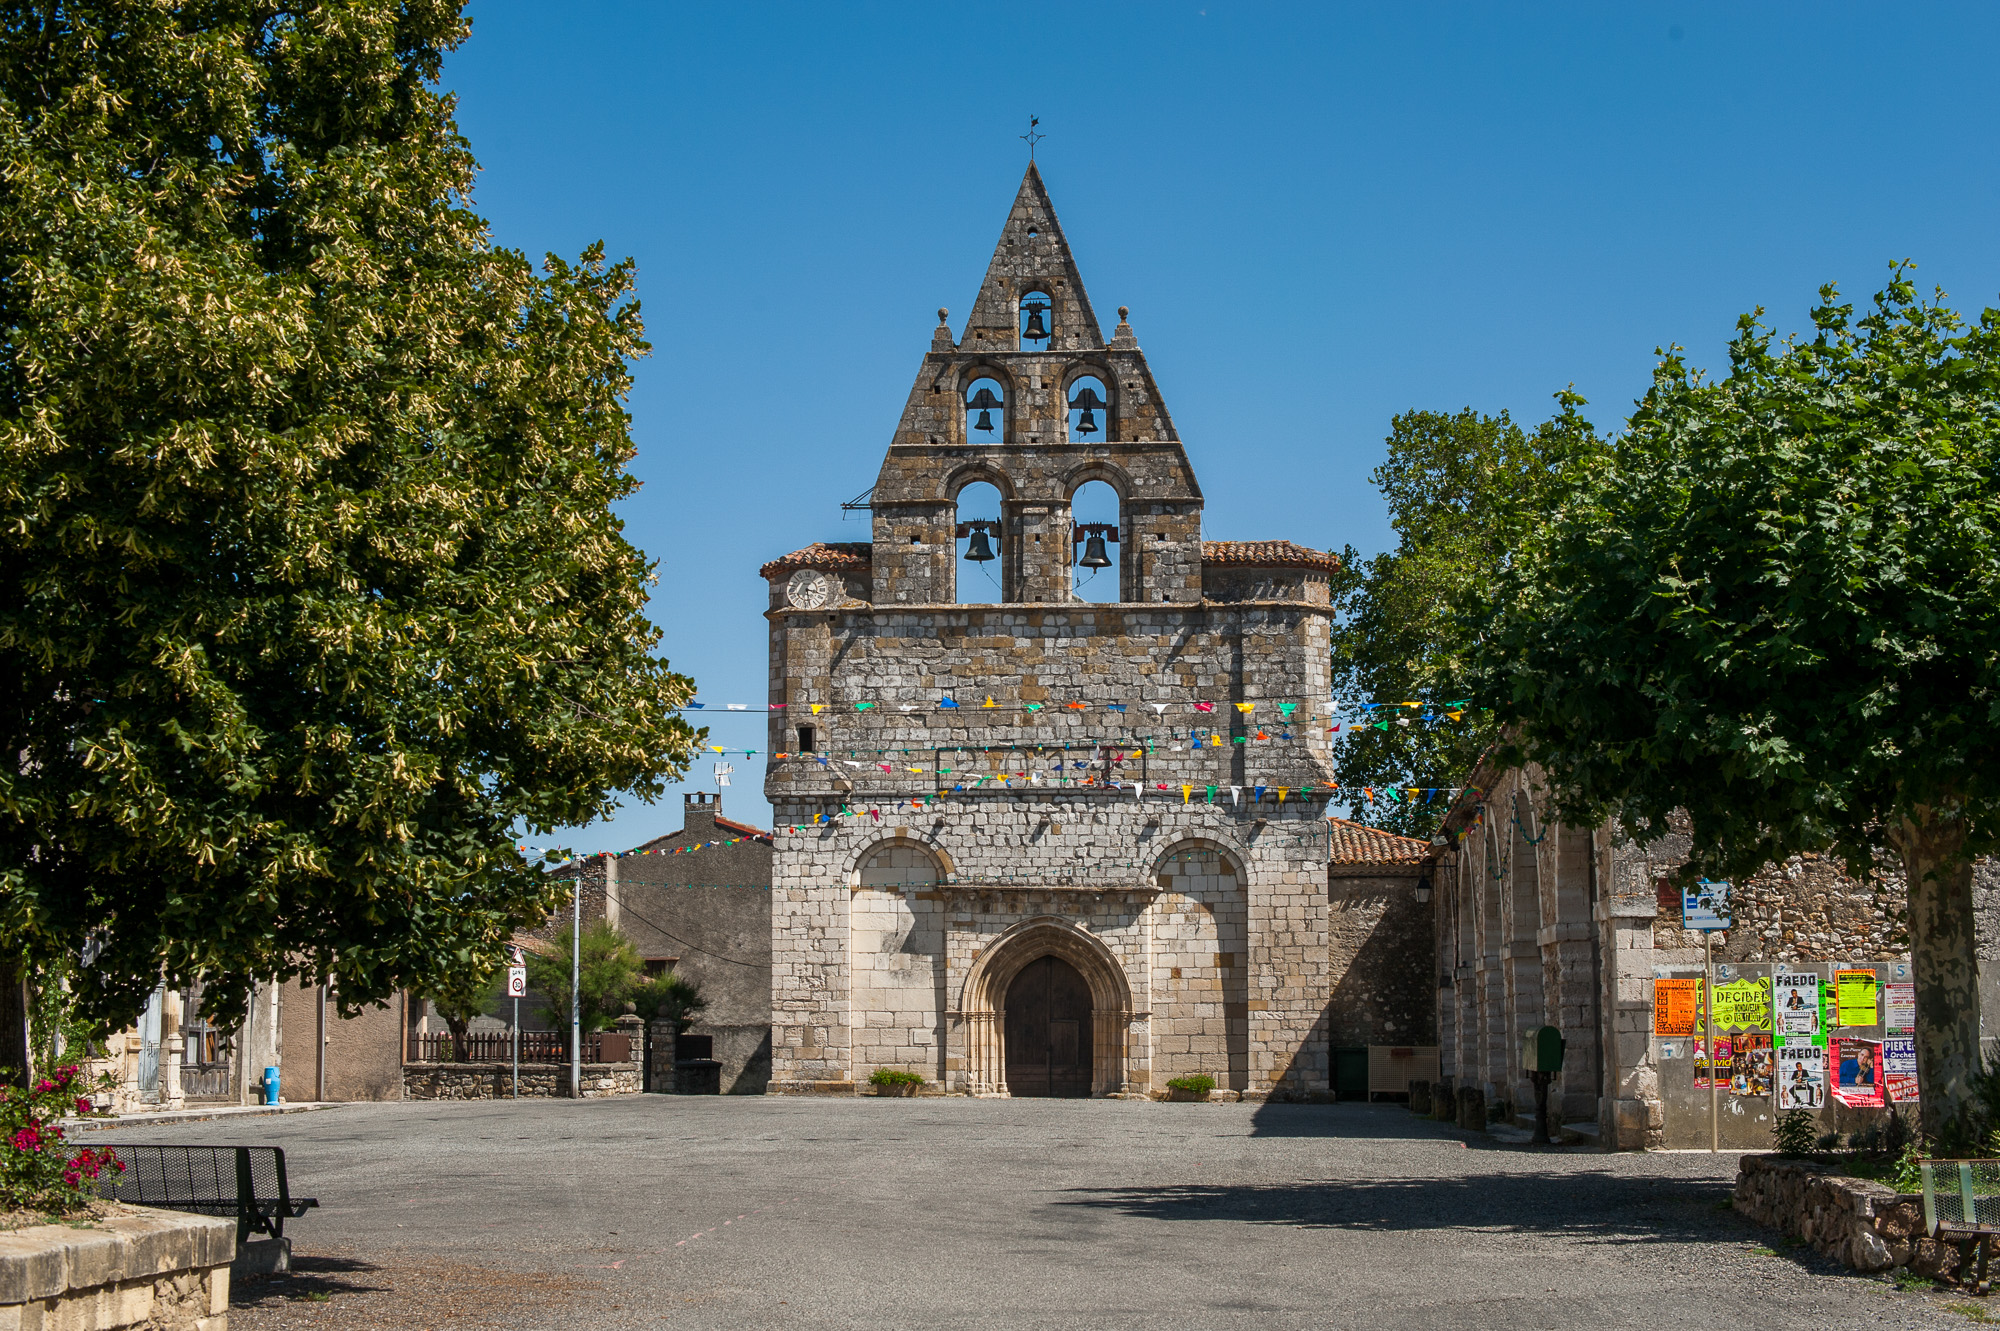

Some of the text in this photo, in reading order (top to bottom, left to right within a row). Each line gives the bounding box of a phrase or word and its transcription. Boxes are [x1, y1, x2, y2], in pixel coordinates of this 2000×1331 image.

[1897, 965, 1905, 977] 5
[1776, 975, 1816, 987] FREDO
[1716, 991, 1766, 1004] DECIBEL
[1780, 1048, 1820, 1059] FREDO
